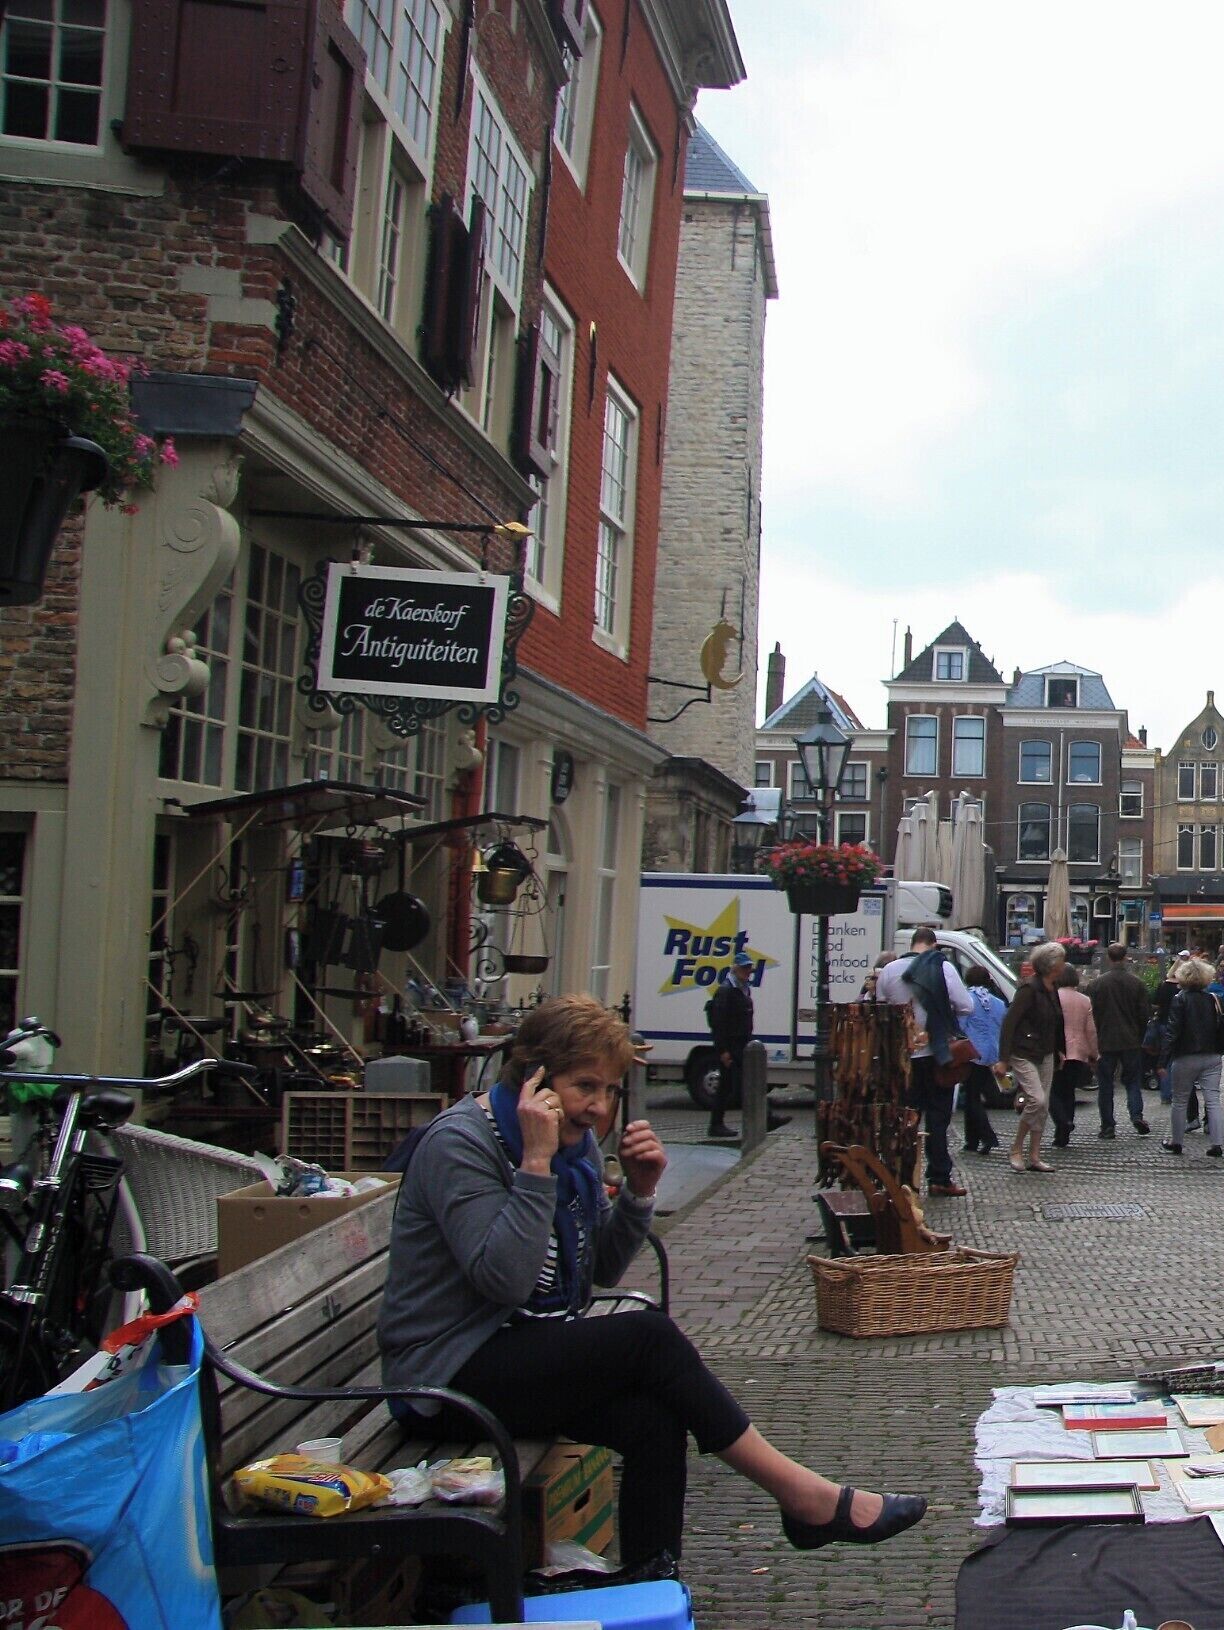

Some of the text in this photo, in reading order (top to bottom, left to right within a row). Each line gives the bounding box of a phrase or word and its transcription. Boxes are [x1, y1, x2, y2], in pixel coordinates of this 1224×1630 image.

[364, 596, 471, 631] de Kaerskorf
[341, 623, 479, 668] Antiquiteiten
[812, 922, 866, 936] Danken
[664, 928, 749, 956] Rust
[811, 938, 844, 952] Fod
[810, 953, 869, 968] Nnfood
[810, 969, 856, 984] Sacks
